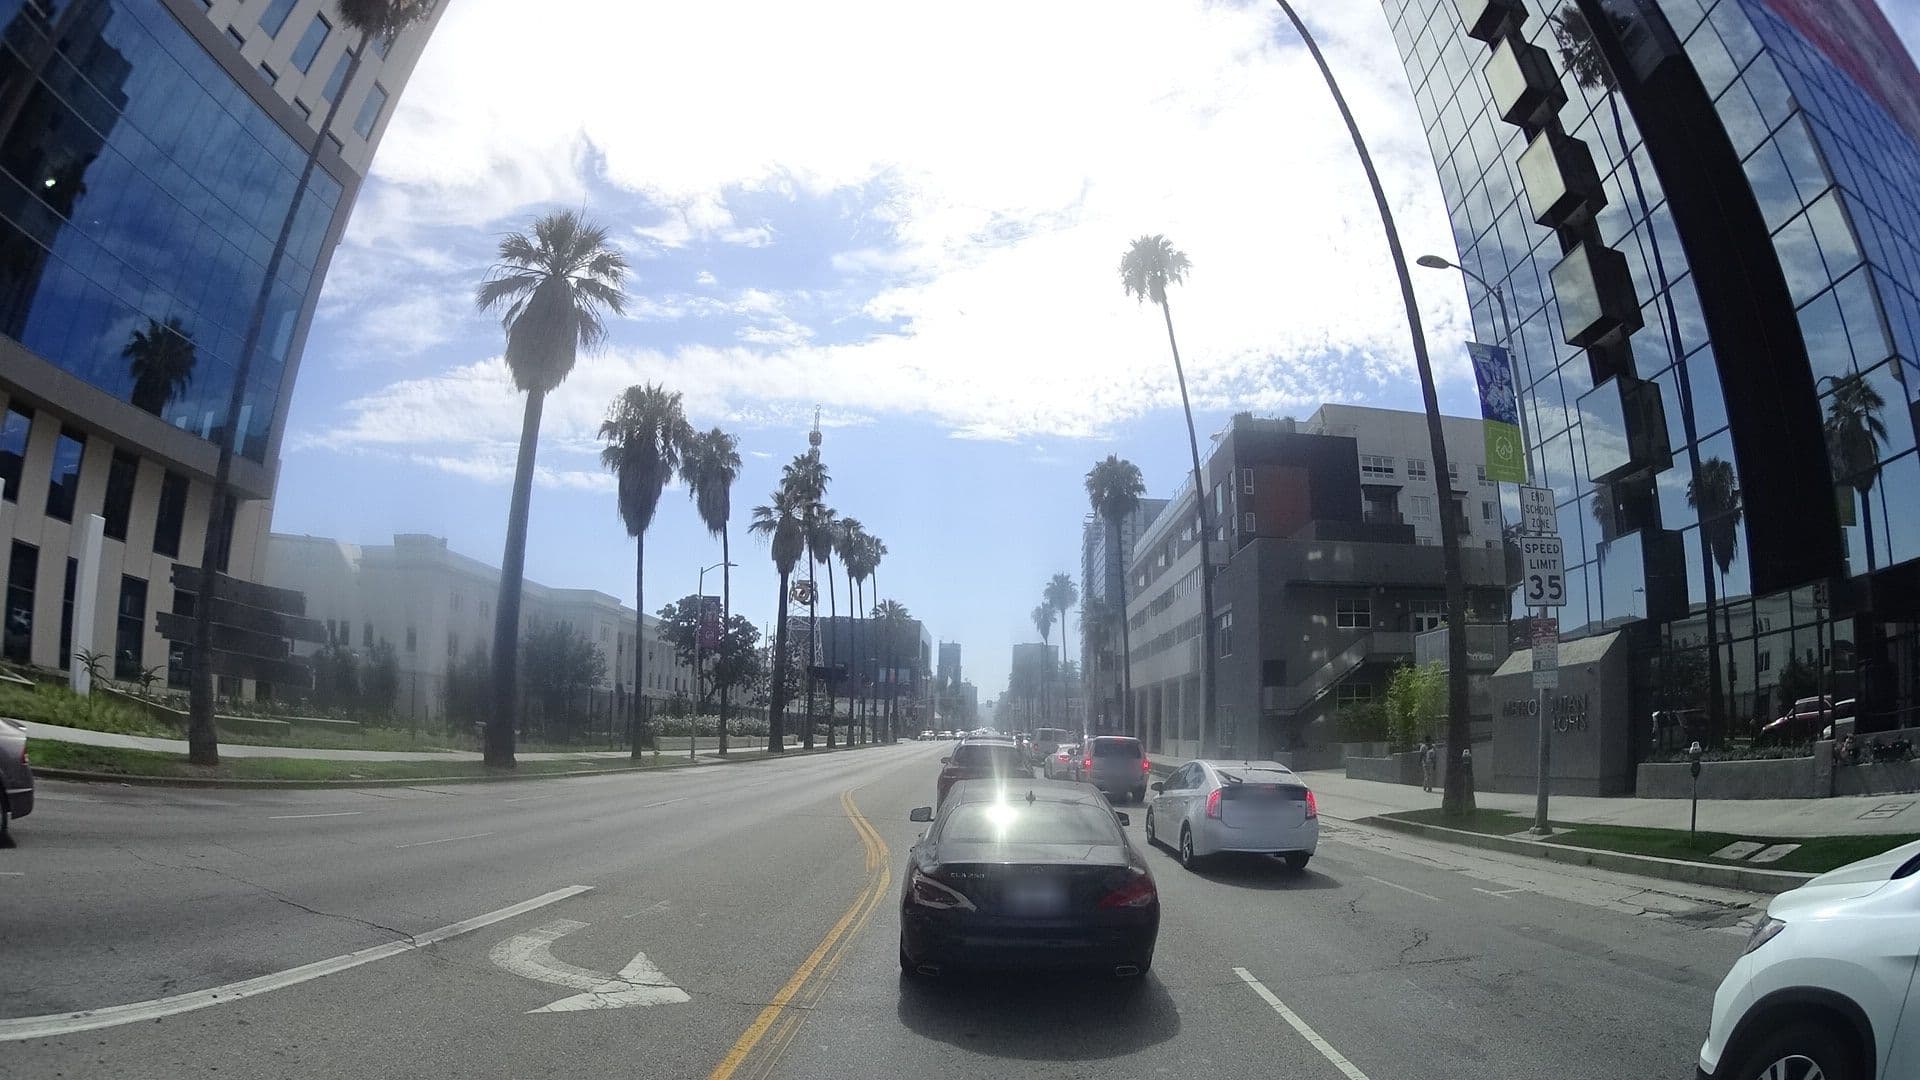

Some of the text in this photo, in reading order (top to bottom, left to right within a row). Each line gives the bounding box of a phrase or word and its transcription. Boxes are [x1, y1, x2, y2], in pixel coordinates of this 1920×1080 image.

[1530, 491, 1545, 502] END
[1525, 504, 1553, 516] SCHOOL
[1531, 518, 1550, 529] ZONE
[1524, 543, 1560, 554] SPEED
[1529, 559, 1557, 570] LIMIT
[1529, 574, 1563, 600] 35
